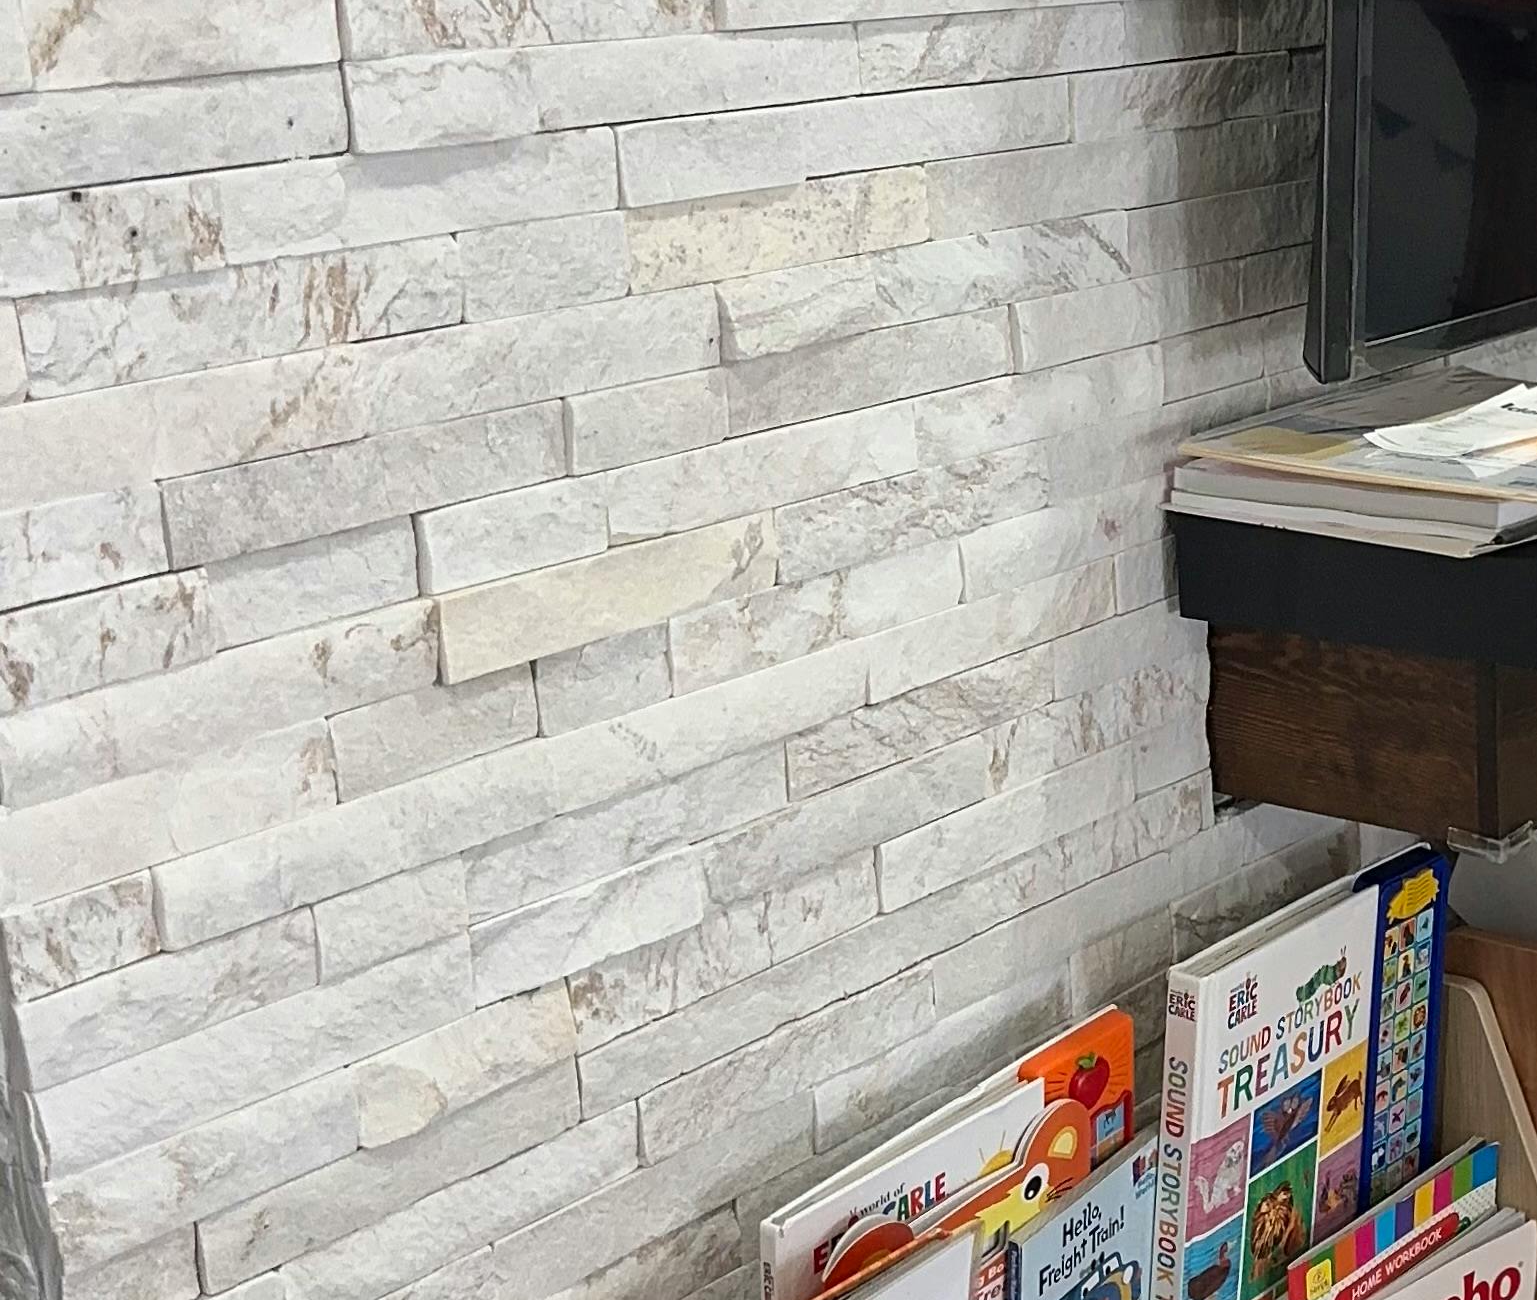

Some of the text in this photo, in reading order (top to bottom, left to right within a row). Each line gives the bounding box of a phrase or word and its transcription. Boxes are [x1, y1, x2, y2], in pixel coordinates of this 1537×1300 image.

[1168, 1005, 1196, 1022] CARLE
[1169, 992, 1196, 1011] ERIC
[1218, 971, 1362, 1074] SOUND STORYBOOK
[1227, 1003, 1258, 1030] CARLE
[1228, 988, 1258, 1013] ERIC
[1217, 999, 1360, 1120] TREASURY
[1165, 1056, 1188, 1139] SOUND
[1062, 1201, 1103, 1249] Hello,
[1156, 1143, 1183, 1283] STORYBOOK
[1038, 1239, 1088, 1298] Freight
[1089, 1206, 1126, 1252] Train!
[1384, 1226, 1443, 1278] WORKBOOK
